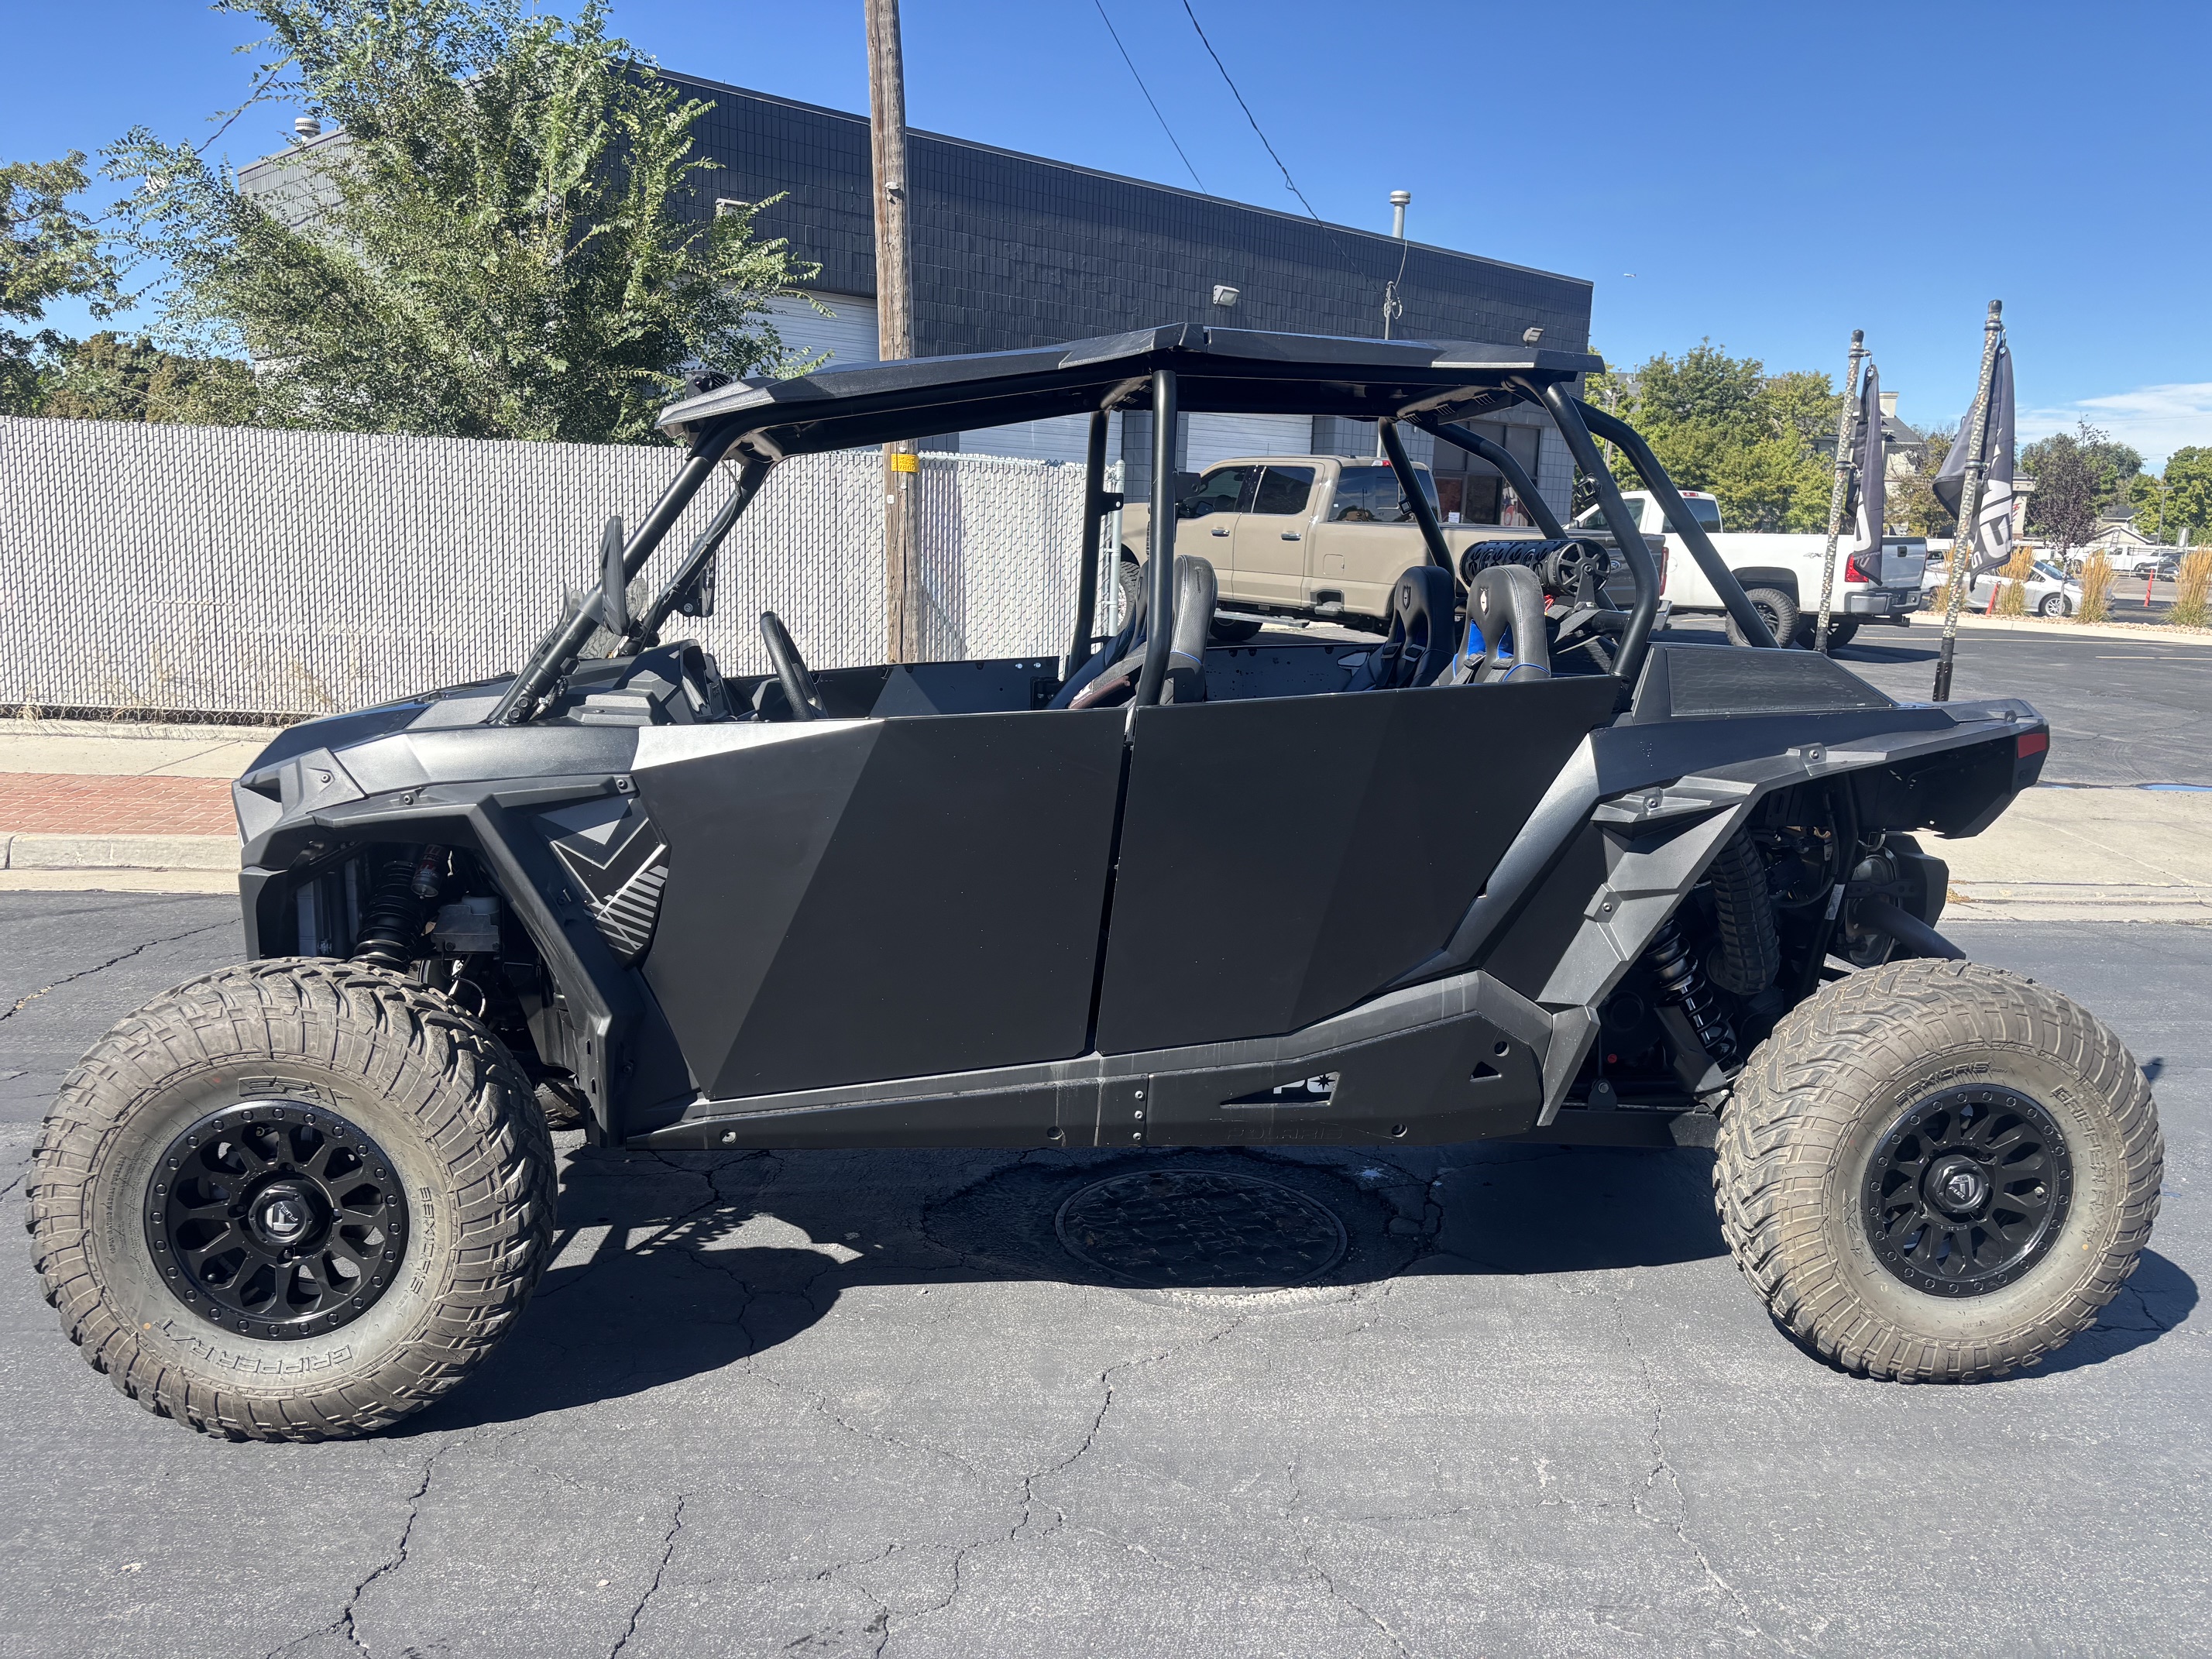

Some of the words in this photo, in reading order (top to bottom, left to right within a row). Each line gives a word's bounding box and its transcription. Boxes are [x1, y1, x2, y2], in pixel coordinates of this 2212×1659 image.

[1228, 1127, 1344, 1139] POLARIS
[2051, 1085, 2107, 1184] GRIPPER
[1949, 1186, 1966, 1200] FUEL
[280, 1201, 298, 1222] FUEL
[216, 1345, 354, 1375] GRIPPER
